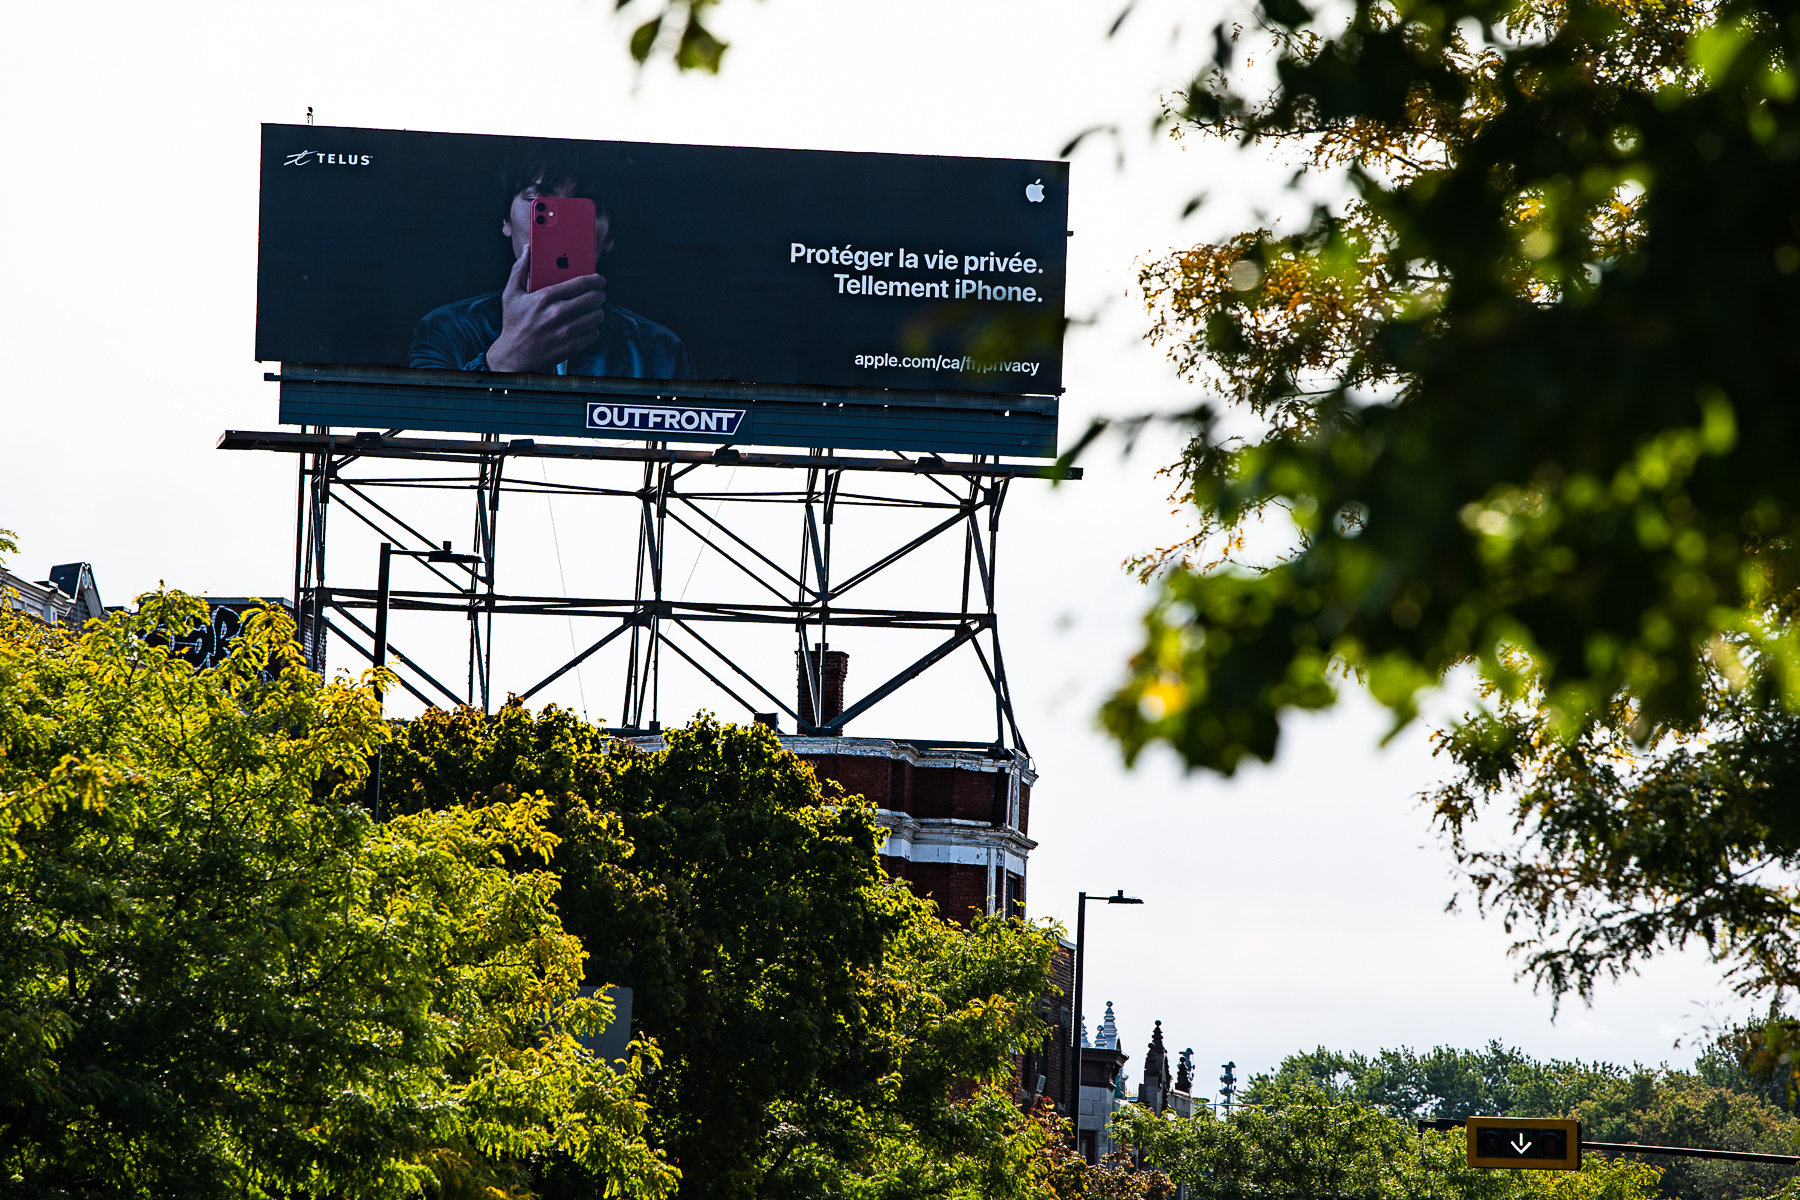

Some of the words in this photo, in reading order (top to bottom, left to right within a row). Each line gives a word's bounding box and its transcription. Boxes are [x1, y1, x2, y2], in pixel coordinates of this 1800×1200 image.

[317, 153, 370, 166] TELUS
[790, 242, 894, 271] Protéger
[899, 248, 919, 269] la
[924, 249, 959, 270] vie
[964, 252, 1044, 275] privée.
[834, 273, 950, 299] Tellement
[954, 279, 1043, 303] iPhone.
[592, 406, 736, 431] OUTFRONT
